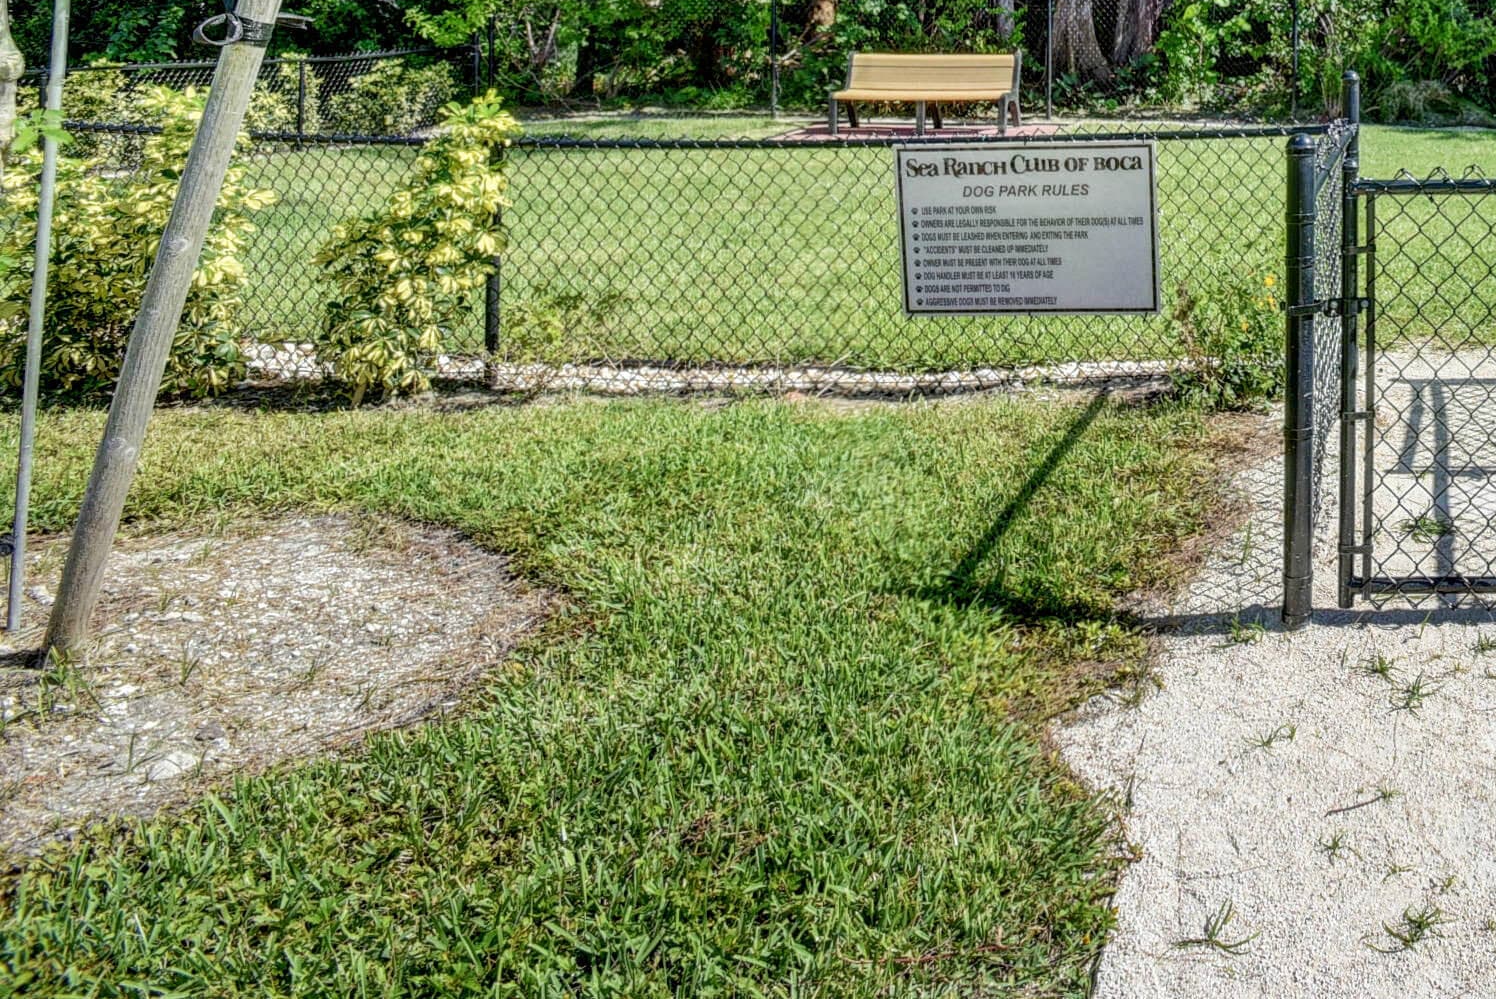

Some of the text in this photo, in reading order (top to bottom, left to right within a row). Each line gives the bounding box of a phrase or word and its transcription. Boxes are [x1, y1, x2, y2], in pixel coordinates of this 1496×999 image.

[906, 158, 939, 177] Sea
[962, 184, 1089, 197] DOG PARK RULES
[921, 206, 996, 215] USE PARK AT YOUR OWN RISK
[921, 219, 944, 228] OWNERS
[945, 219, 955, 228] ARE
[956, 219, 978, 228] LEGALLY
[980, 219, 1015, 227] RESPONSIBLE
[1017, 218, 1028, 227] FOR
[1028, 218, 1038, 227] THE
[1040, 218, 1065, 226] BEHAVIOR
[1067, 217, 1074, 226] OF
[1075, 217, 1090, 226] THEIR
[1109, 217, 1117, 225] AT
[1117, 217, 1127, 225] ALL
[1128, 216, 1144, 225] TIMES
[922, 231, 1088, 241] DOGS MUST BE LEASHED WHEN ENTERING AND EXITING THE PARK
[958, 245, 973, 253] MUST
[974, 245, 981, 253] BE
[982, 245, 1006, 253] CLEANED
[1007, 245, 1014, 253] UP
[1015, 244, 1048, 253] IMMEDIATELY
[923, 259, 941, 267] OWNER
[943, 259, 956, 267] MUST
[957, 259, 964, 267] BE
[965, 258, 988, 266] PRESENT
[989, 258, 1001, 266] WITH
[1003, 258, 1017, 266] THEIR
[1018, 258, 1029, 266] DOG
[1030, 258, 1036, 266] AT
[1047, 257, 1062, 265] TIMES
[924, 272, 935, 280] DOG
[937, 272, 960, 280] HANDLER
[961, 272, 976, 280] MUST
[976, 271, 984, 279] BE
[985, 271, 991, 279] AT
[993, 271, 1009, 279] LEAST
[1016, 271, 1033, 279] YEARS
[1035, 271, 1042, 279] OF
[1042, 270, 1054, 279] AGE
[924, 284, 1010, 293] DOGS ARE NOT PERMITTED TO DIG
[926, 296, 1057, 306] AGGRESSIVE DOGS MUST BE REMOVED IMMEDIATELY
